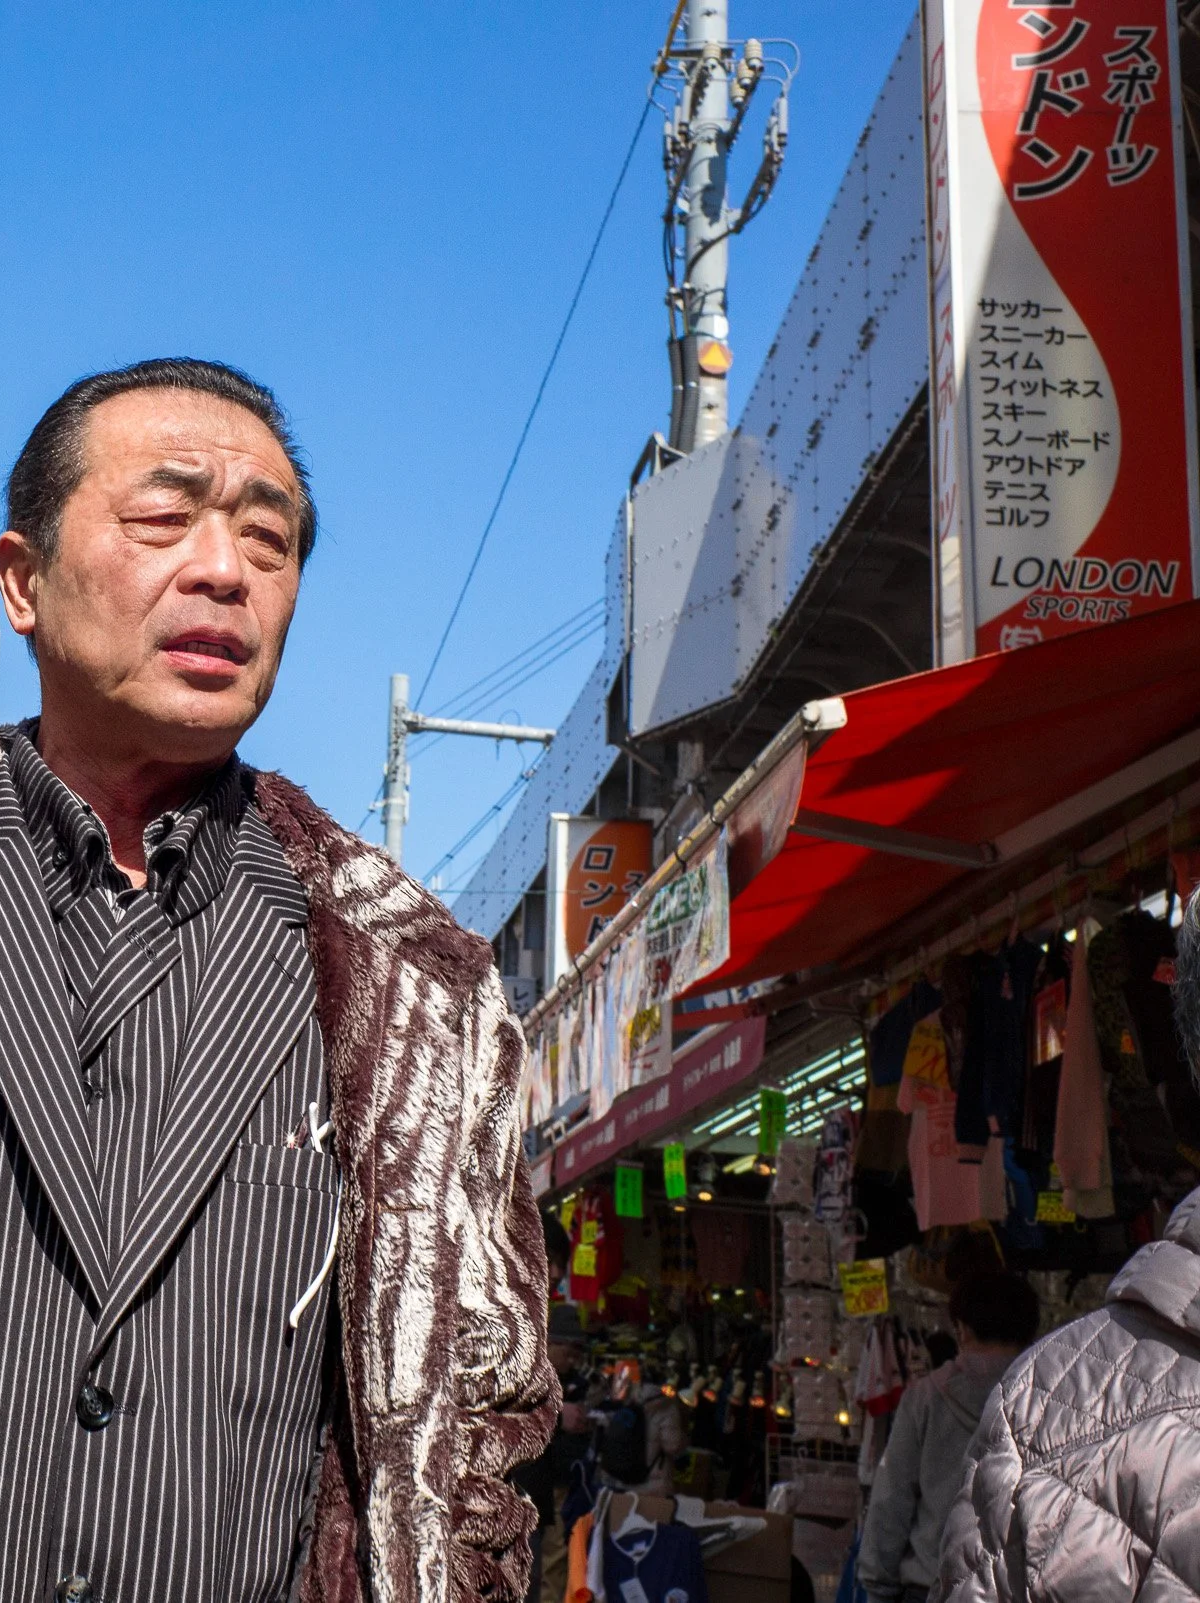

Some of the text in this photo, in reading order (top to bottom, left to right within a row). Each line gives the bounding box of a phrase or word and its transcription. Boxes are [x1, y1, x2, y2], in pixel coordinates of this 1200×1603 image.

[1007, 0, 1096, 200] ンドン
[1103, 26, 1160, 186] スポーツ
[978, 298, 1063, 319] サッカー
[979, 324, 1087, 346] スニーカー
[979, 350, 1044, 371] スイム
[979, 376, 1104, 399] フィットネス
[981, 402, 1046, 422] スキー
[982, 428, 1111, 452] スノーボード
[983, 454, 1086, 477] アウトドア
[984, 481, 1051, 502] テニス
[985, 506, 1051, 528] ゴルフ
[990, 555, 1179, 596] LONDON
[1023, 596, 1132, 622] SPORTS
[581, 844, 618, 986] ロンド
